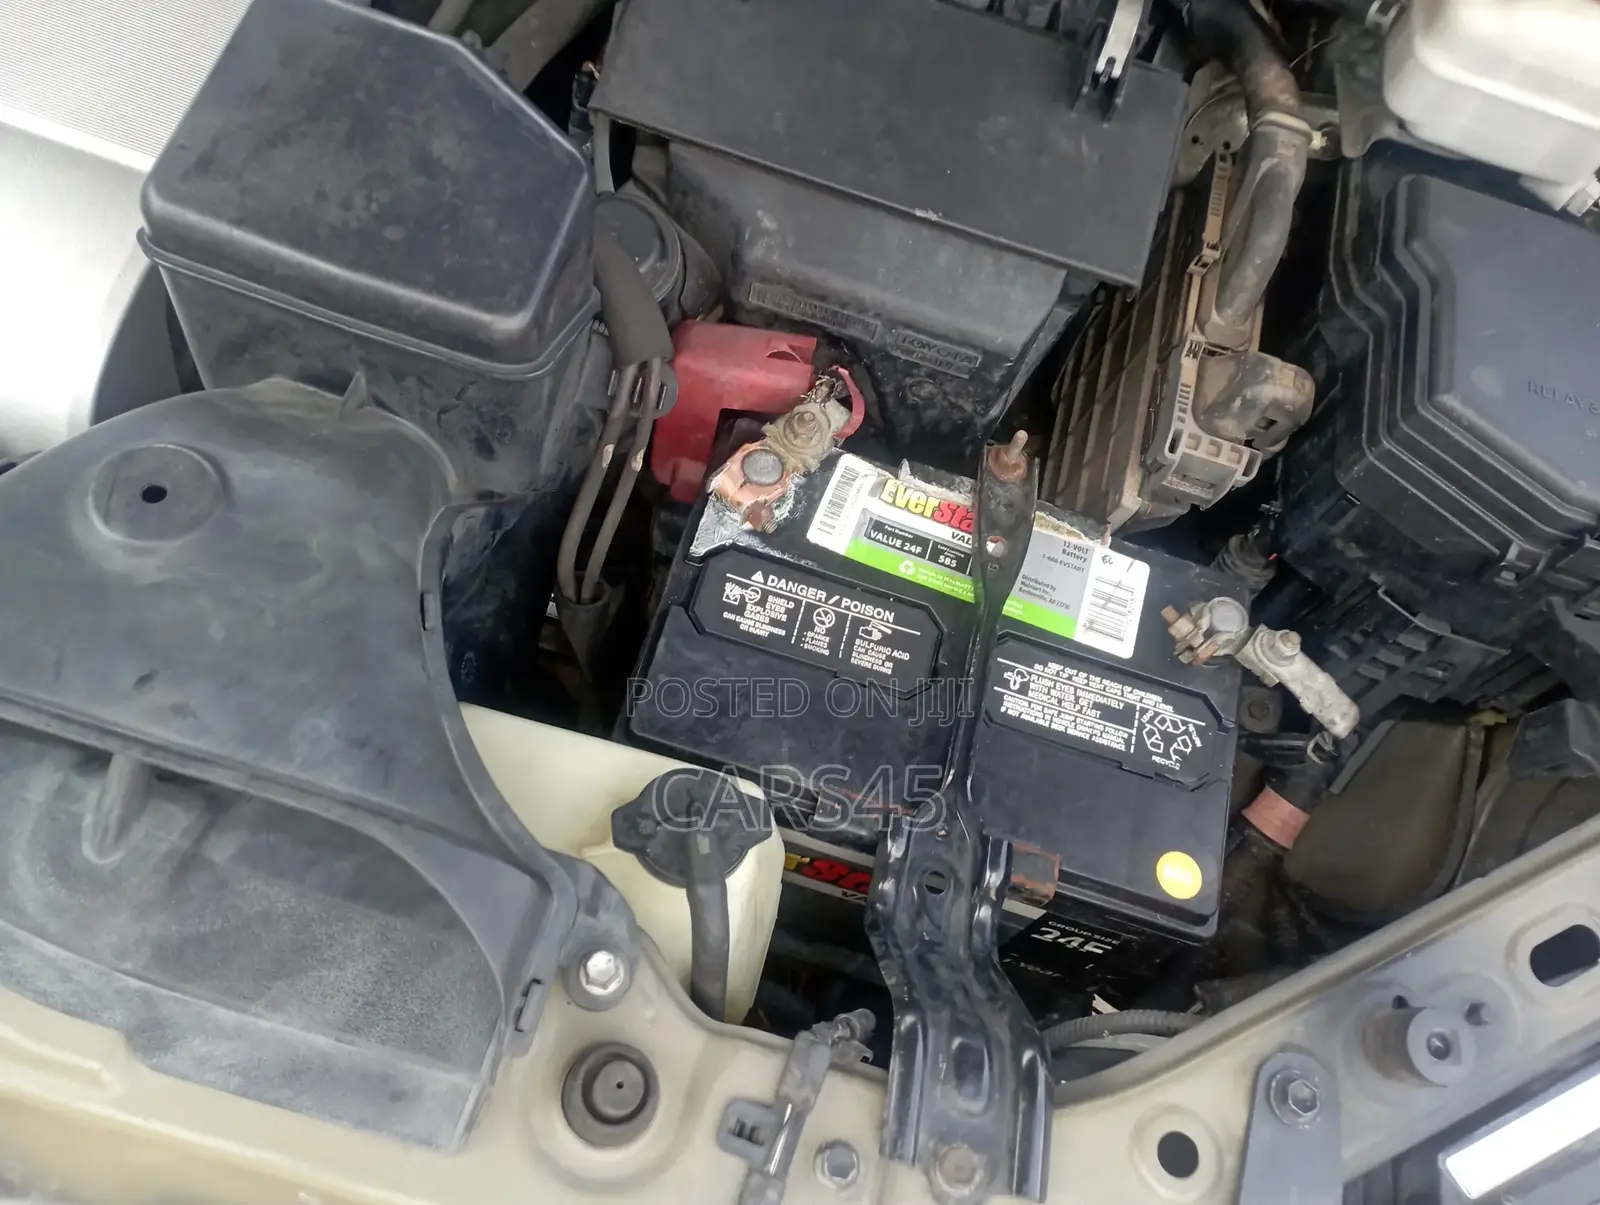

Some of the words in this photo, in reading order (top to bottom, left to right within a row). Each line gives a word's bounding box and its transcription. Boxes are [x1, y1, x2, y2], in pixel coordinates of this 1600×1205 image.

[1527, 379, 1586, 409] RELAY
[871, 530, 902, 547] VALUE
[903, 542, 922, 553] 24F
[1062, 541, 1089, 553] 12-VOLT
[938, 555, 956, 567] 585
[1061, 548, 1087, 562] Battery
[767, 575, 826, 602] DANGER
[841, 597, 894, 623] POISON
[767, 595, 794, 608] SHIELD
[746, 603, 787, 621] EXPLOSIVE
[765, 602, 785, 613] EYES
[723, 611, 736, 620] CAN
[736, 616, 755, 626] CAUSE
[755, 622, 785, 636] BLINDNESS
[744, 610, 769, 623] GASES
[740, 623, 749, 631] OR
[814, 626, 825, 634] NO
[805, 637, 827, 648] FLAMES
[807, 631, 829, 642] SPARKS
[804, 643, 829, 655] SMOKING
[853, 645, 865, 653] CAN
[868, 649, 886, 660] CAUSE
[855, 638, 891, 655] SULFURIC
[891, 650, 909, 660] ACID
[852, 651, 882, 665] BLINDNESS
[851, 657, 872, 668] SEVERE
[872, 664, 891, 674] BURNS
[1034, 663, 1043, 671] DO
[1044, 667, 1057, 675] NOT
[1072, 676, 1088, 684] KEEP
[1089, 681, 1104, 689] VENT
[1106, 686, 1121, 695] CAPS
[1048, 662, 1063, 670] KEEP
[1064, 667, 1077, 675] OUT
[1089, 675, 1101, 683] THE
[1102, 679, 1122, 690] REACH
[1030, 674, 1054, 687] FLUSH
[1056, 682, 1074, 694] EYES
[1076, 689, 1124, 709] IMMEDIATELY
[1030, 682, 1048, 693] WITH
[1079, 697, 1093, 707] GET
[1028, 690, 1059, 705] MEDICAL
[1061, 700, 1080, 711] HELP
[1082, 706, 1101, 718] FAST
[1030, 703, 1042, 711] FOR
[1007, 708, 1020, 717] NOT
[1048, 920, 1091, 936] GROUP
[1092, 934, 1120, 945] SIZE
